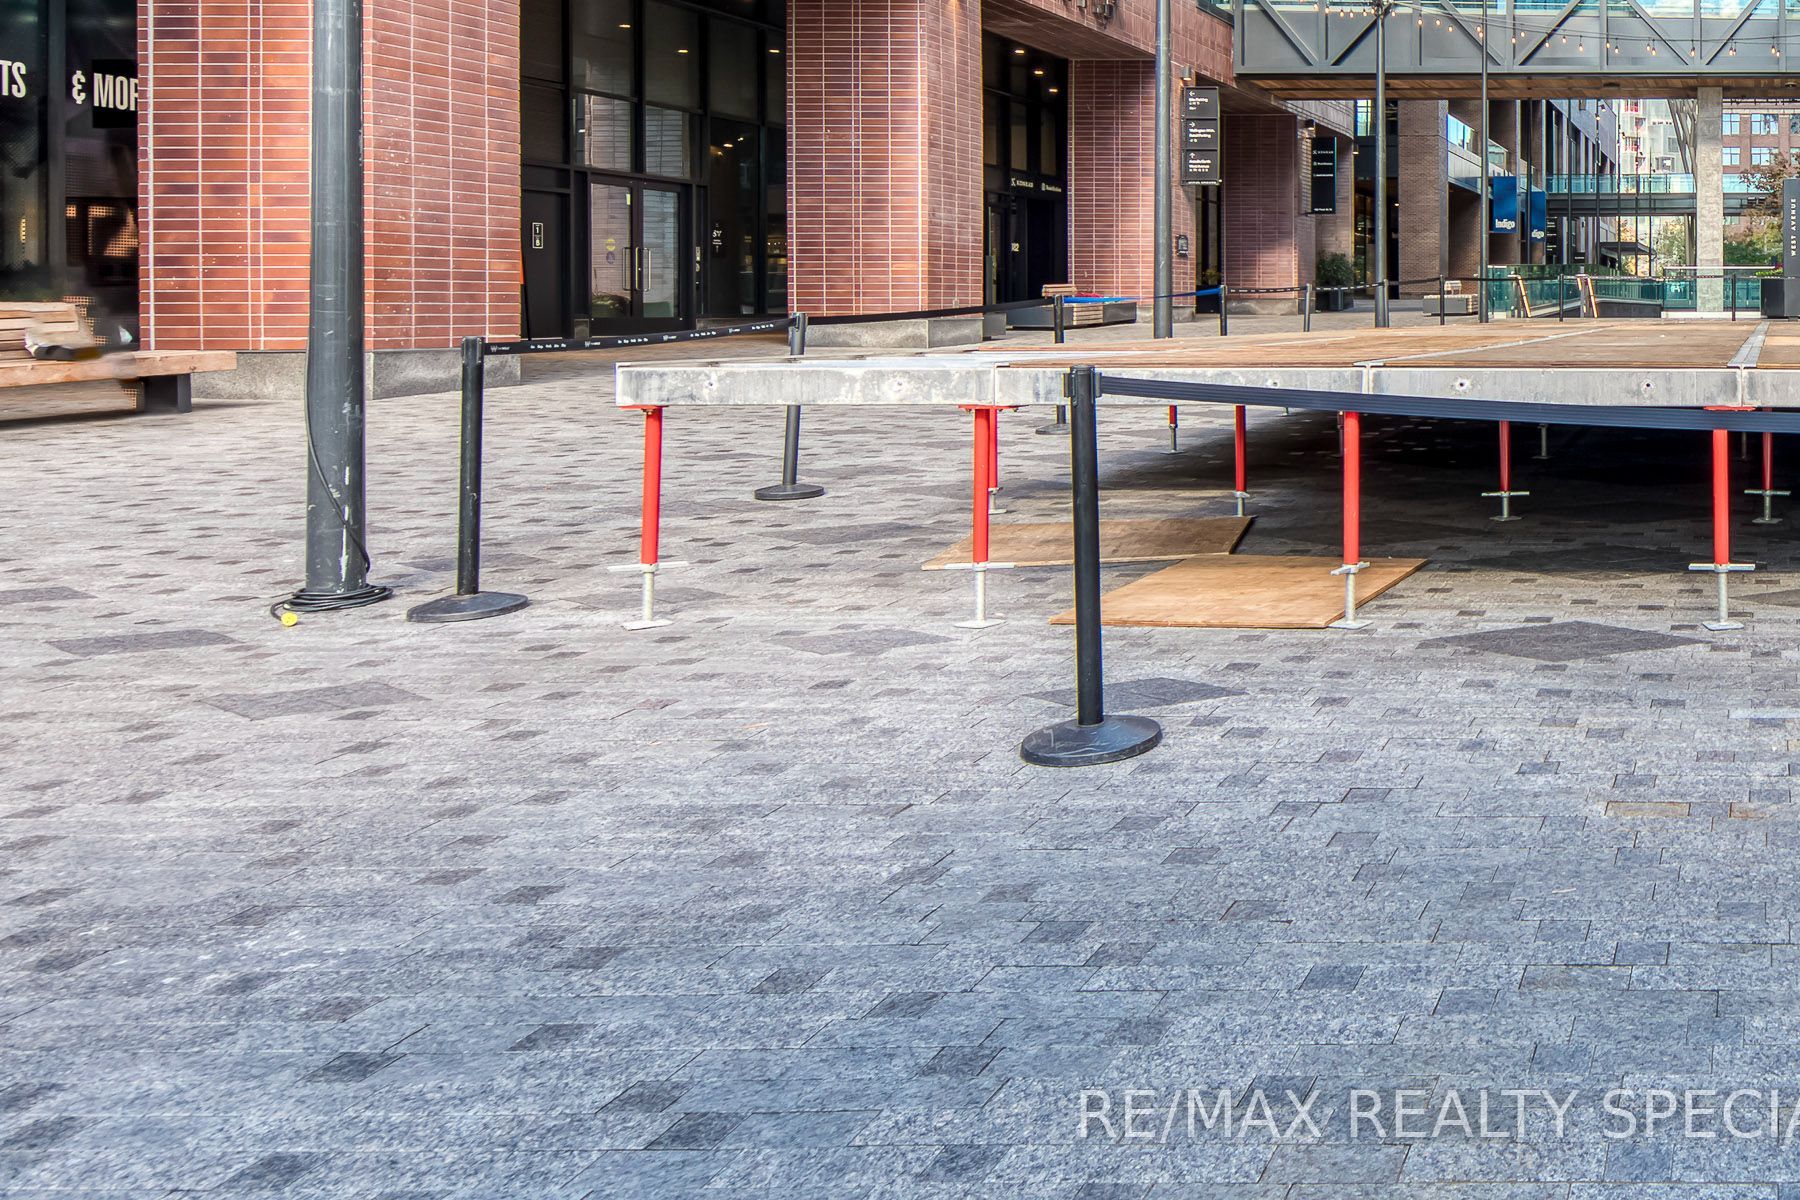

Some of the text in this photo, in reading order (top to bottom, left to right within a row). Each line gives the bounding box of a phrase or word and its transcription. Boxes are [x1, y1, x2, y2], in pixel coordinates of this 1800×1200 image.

[72, 70, 87, 104] &
[1495, 218, 1516, 230] Indigo
[1531, 229, 1545, 240] digo
